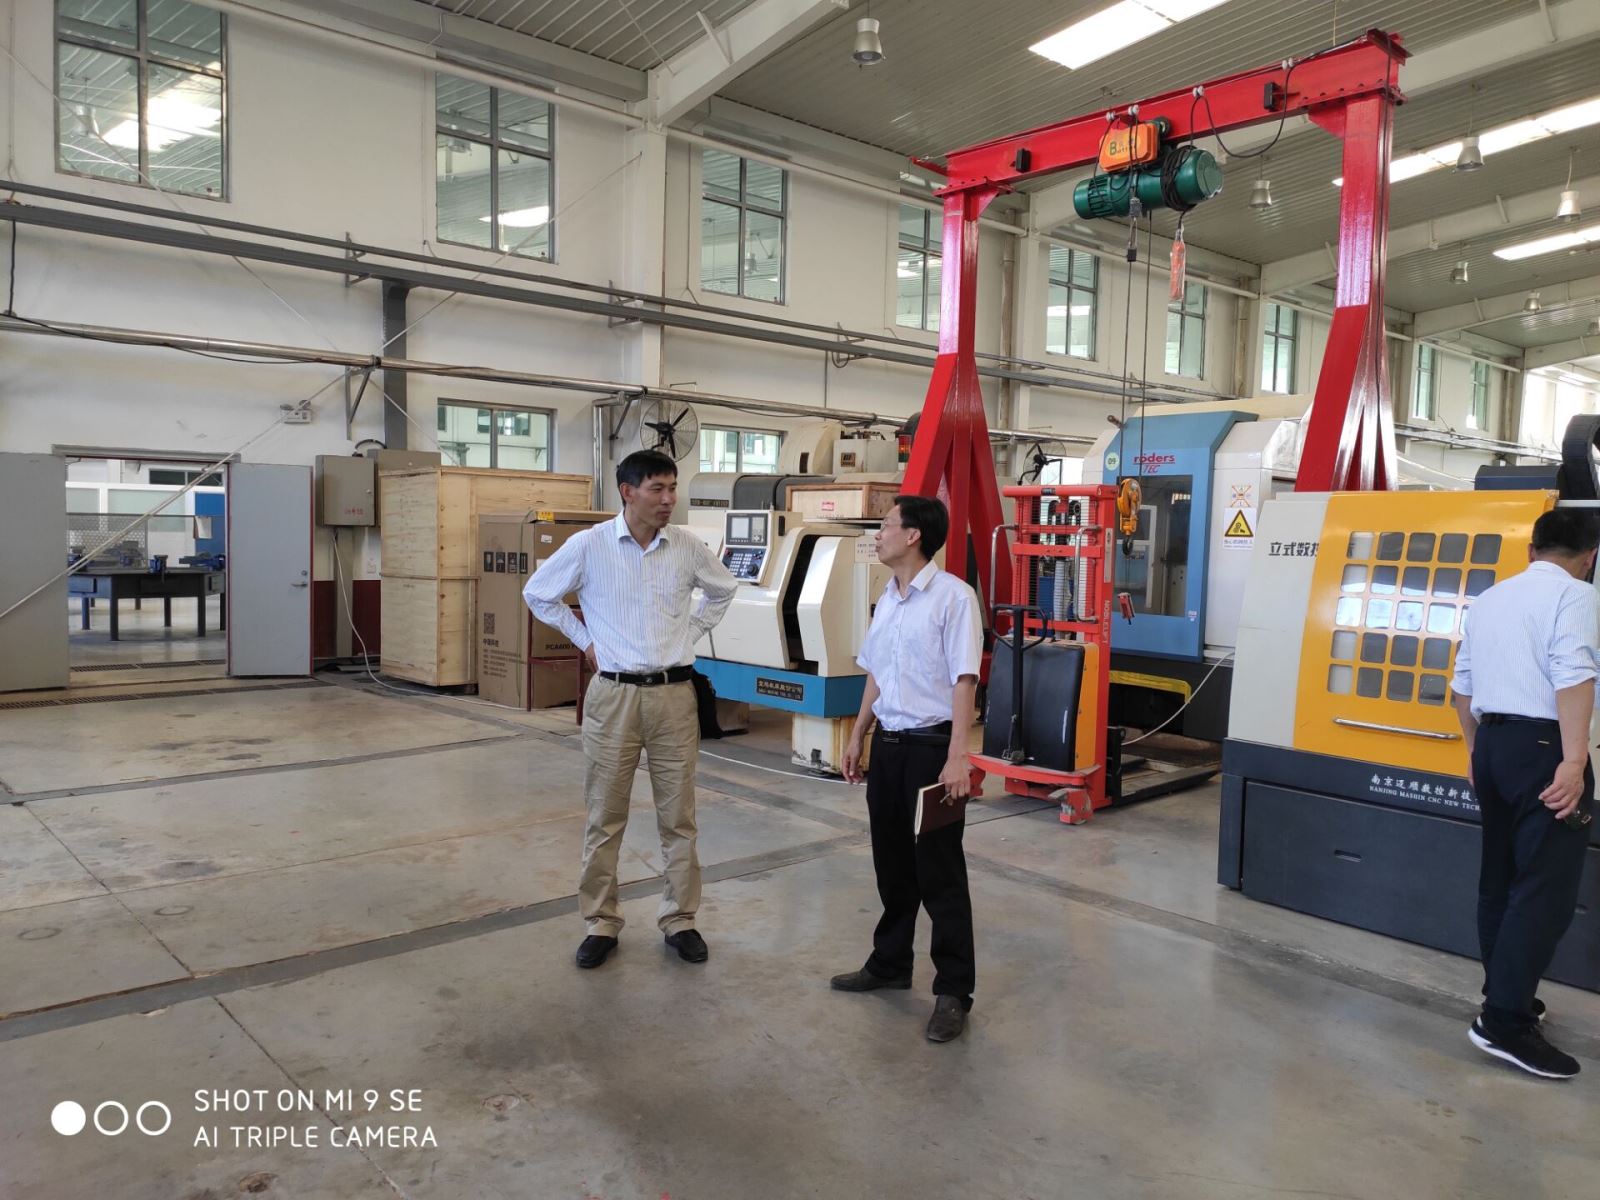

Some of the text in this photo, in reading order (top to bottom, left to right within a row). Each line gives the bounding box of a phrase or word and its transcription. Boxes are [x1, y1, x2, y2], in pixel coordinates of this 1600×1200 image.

[1369, 785, 1397, 796] NANJING
[1427, 796, 1442, 804] CNC
[1444, 799, 1459, 807] NEW
[1462, 802, 1481, 811] TECH
